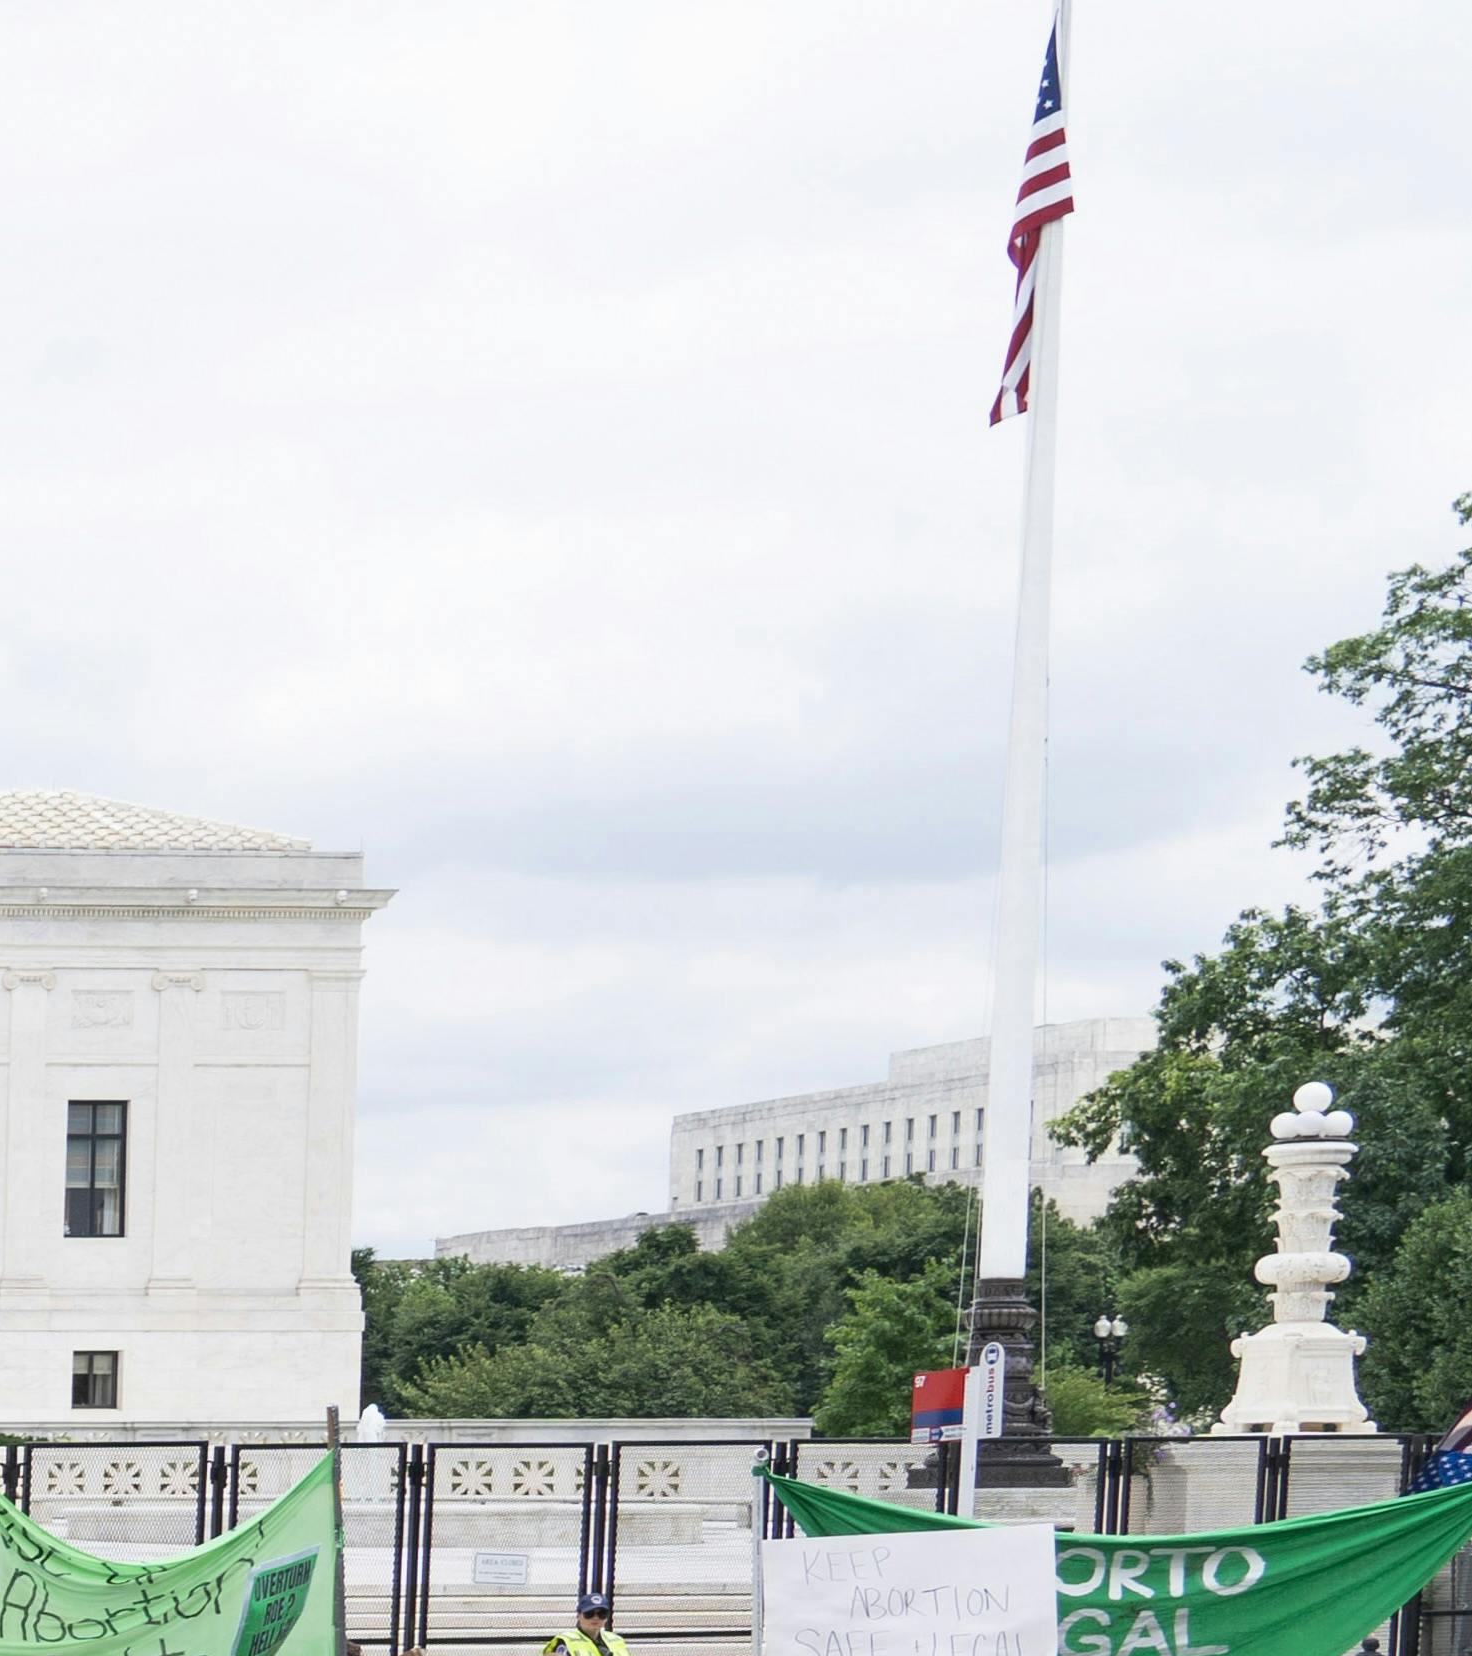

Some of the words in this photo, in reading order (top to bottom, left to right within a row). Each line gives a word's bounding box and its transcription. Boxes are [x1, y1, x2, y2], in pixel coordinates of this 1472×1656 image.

[985, 1367, 995, 1435] metrobus
[254, 1558, 312, 1601] OVERTURN
[801, 1546, 890, 1586] KEEP
[1055, 1546, 1266, 1600] ORTO
[849, 1584, 1010, 1619] ABORTION
